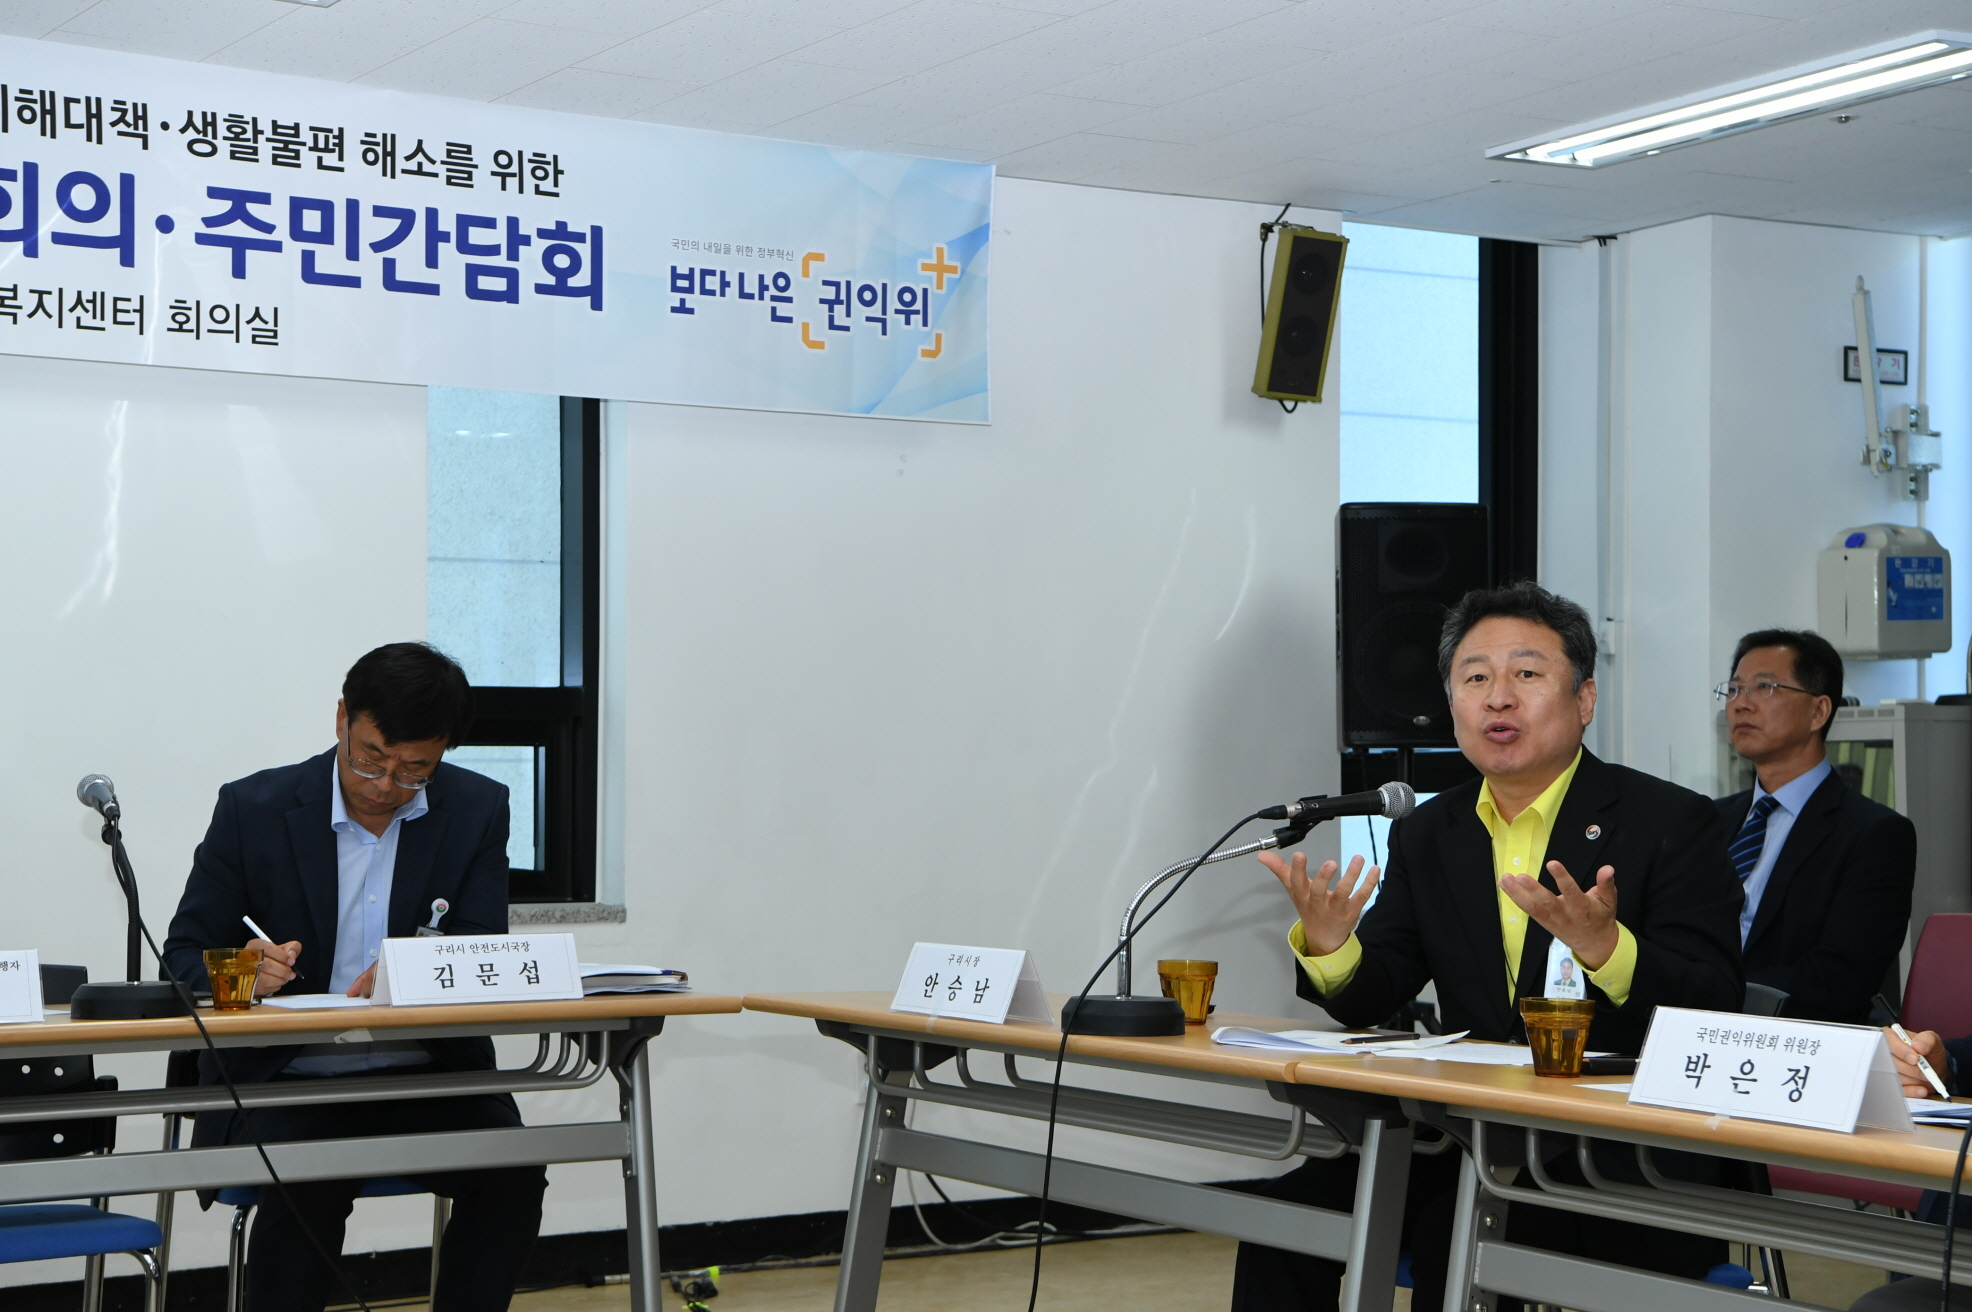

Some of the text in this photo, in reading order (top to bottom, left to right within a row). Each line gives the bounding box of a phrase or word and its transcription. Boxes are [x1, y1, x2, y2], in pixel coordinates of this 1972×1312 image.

[0, 83, 565, 198] 해대책·생활불편 해소를 위한
[670, 238, 794, 262] 국민의 내일을 위한 정부혁신
[166, 298, 279, 347] 회의실
[818, 279, 929, 337] 권익위
[434, 940, 531, 956] 구리시 안전도시국장
[947, 953, 981, 968] 구리시장
[1696, 1027, 1822, 1056] 국민권익위원회 위원장
